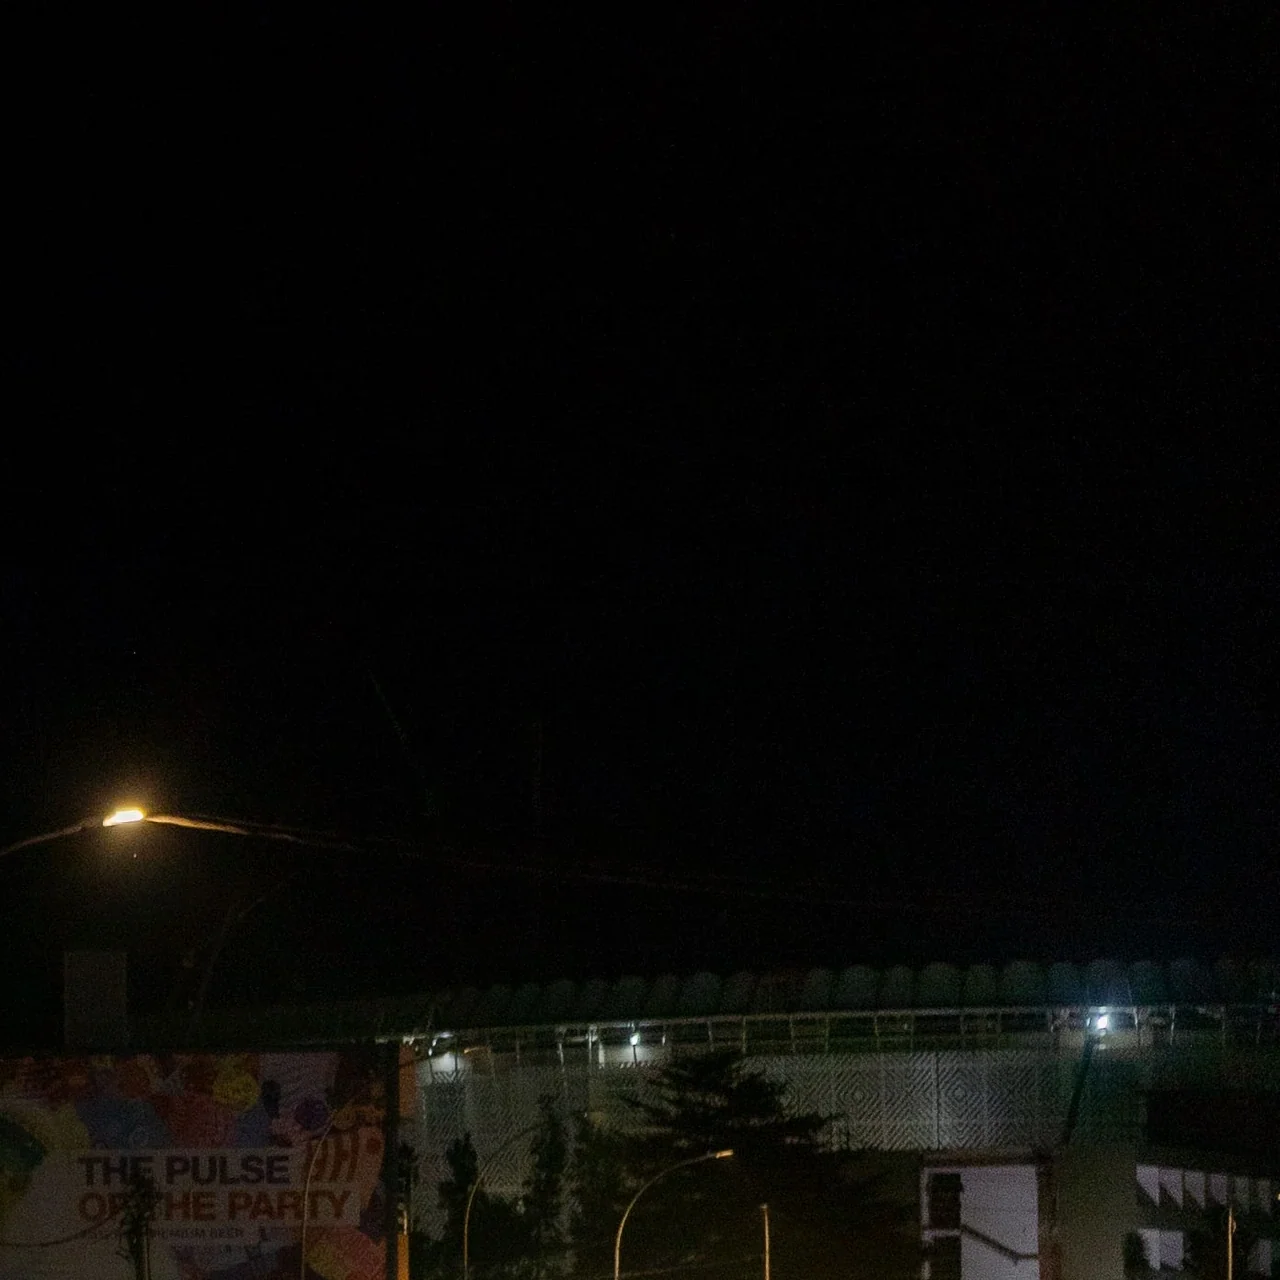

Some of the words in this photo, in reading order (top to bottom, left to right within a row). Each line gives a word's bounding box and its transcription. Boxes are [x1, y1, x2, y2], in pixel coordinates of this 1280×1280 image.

[77, 1156, 154, 1185] THE
[165, 1155, 290, 1184] PULSE
[228, 1190, 351, 1220] PARTY
